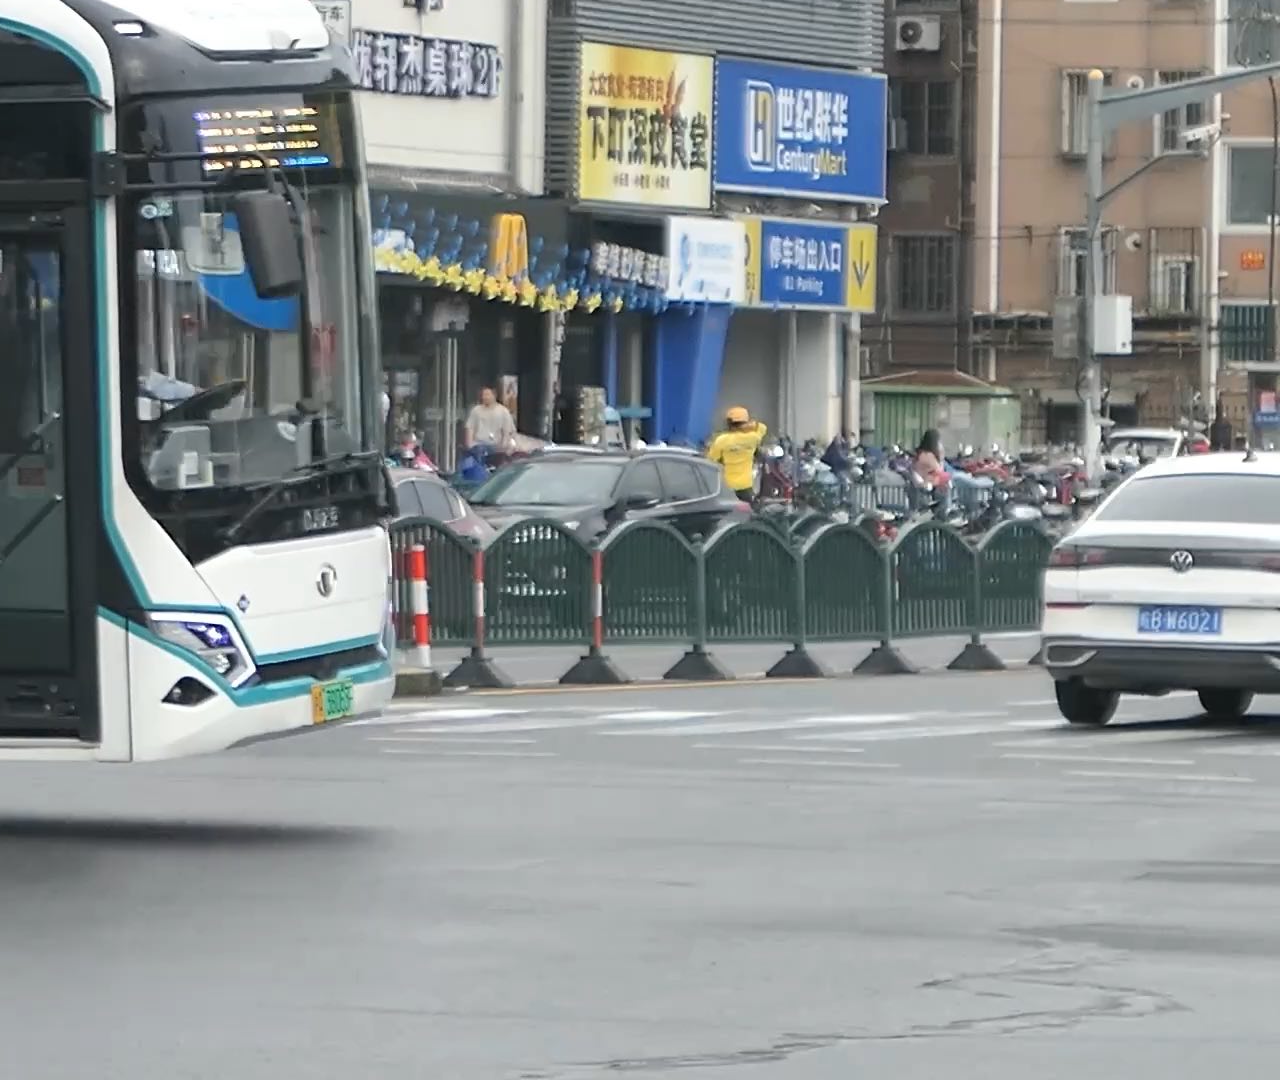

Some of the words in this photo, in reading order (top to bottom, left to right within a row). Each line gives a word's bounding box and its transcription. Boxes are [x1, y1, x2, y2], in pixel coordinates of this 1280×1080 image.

[777, 88, 848, 145] 世纪联华
[776, 144, 848, 181] CenturyMart
[769, 235, 841, 272] 停车场出入口
